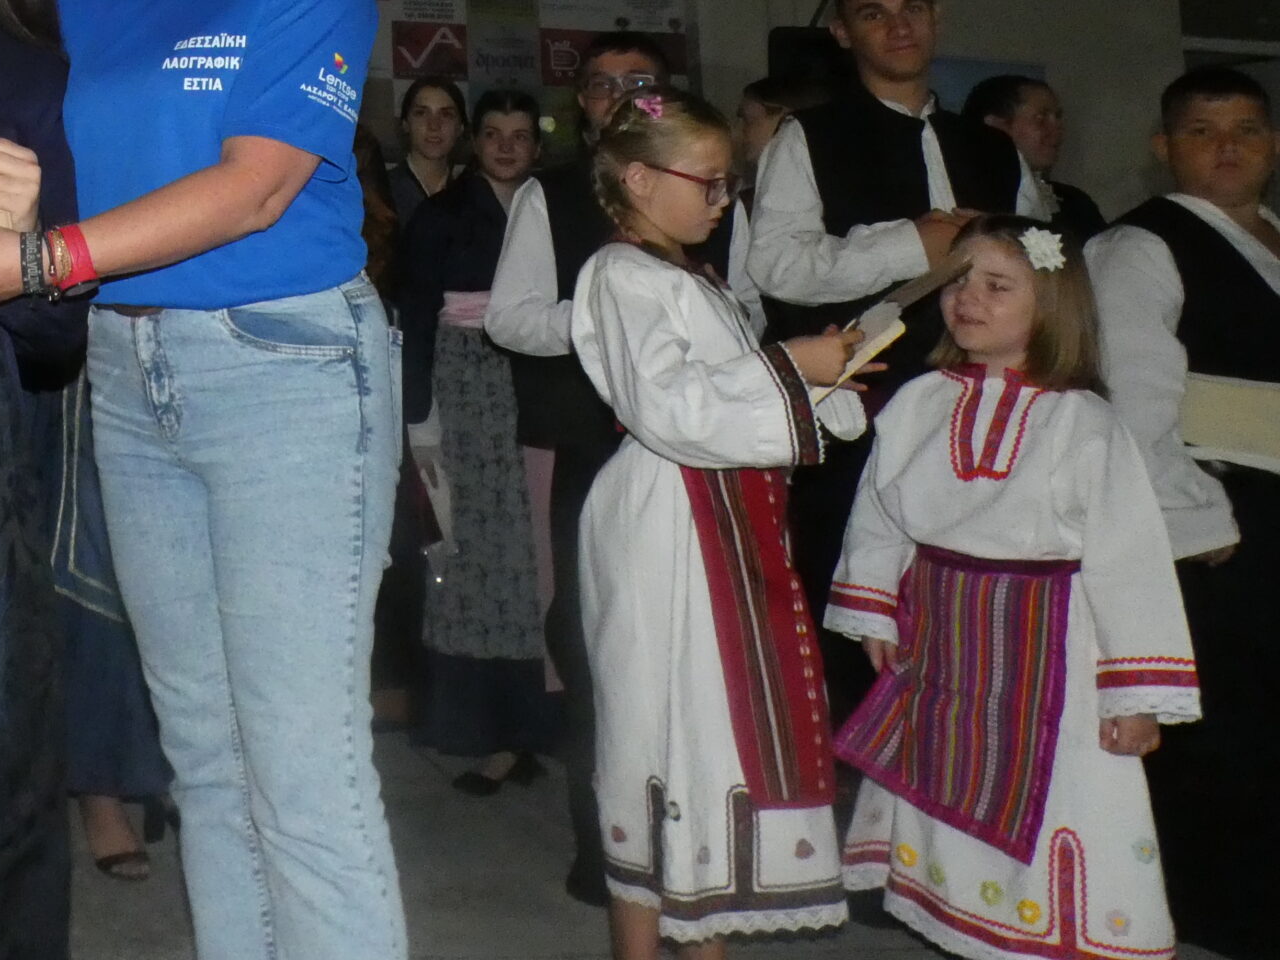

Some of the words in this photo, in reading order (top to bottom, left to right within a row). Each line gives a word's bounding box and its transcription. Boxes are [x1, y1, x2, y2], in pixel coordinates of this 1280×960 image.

[173, 33, 246, 50] ΕΔΕΣΣΑΪΚΗ
[162, 56, 243, 70] ΛΑΟΓΡΑΦΙΚ
[183, 77, 223, 91] ΕΣΤΙΑ
